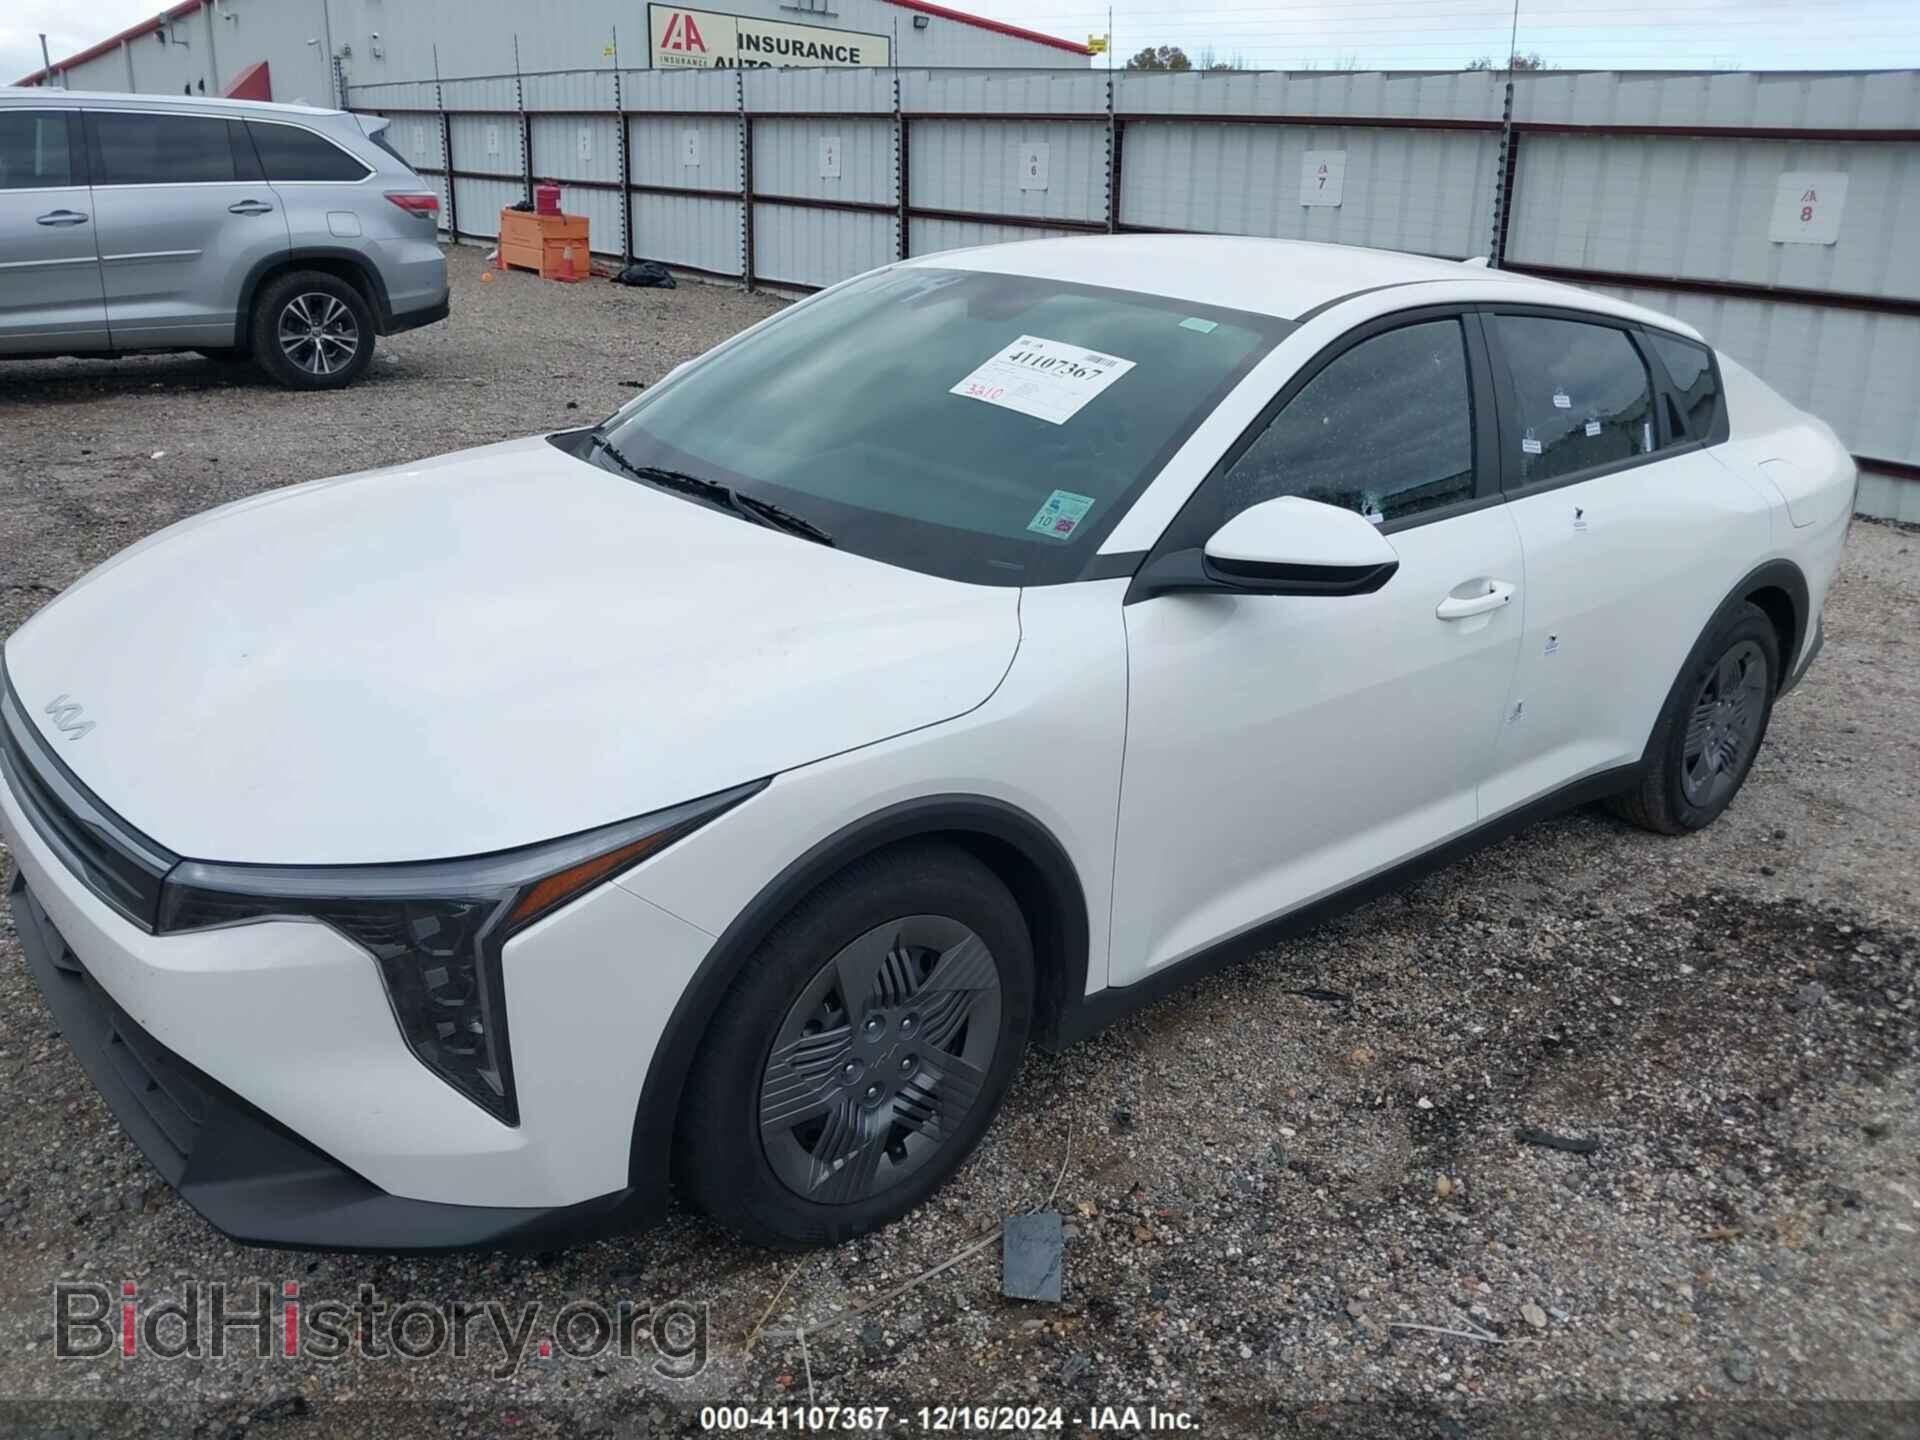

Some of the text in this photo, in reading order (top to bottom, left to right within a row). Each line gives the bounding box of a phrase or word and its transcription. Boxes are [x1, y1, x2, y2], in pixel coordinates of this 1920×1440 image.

[737, 33, 861, 64] INSURANCE
[660, 55, 708, 67] INSURANCE
[1318, 177, 1327, 190] 7
[1800, 206, 1813, 222] 8
[1008, 351, 1103, 381] 41107367
